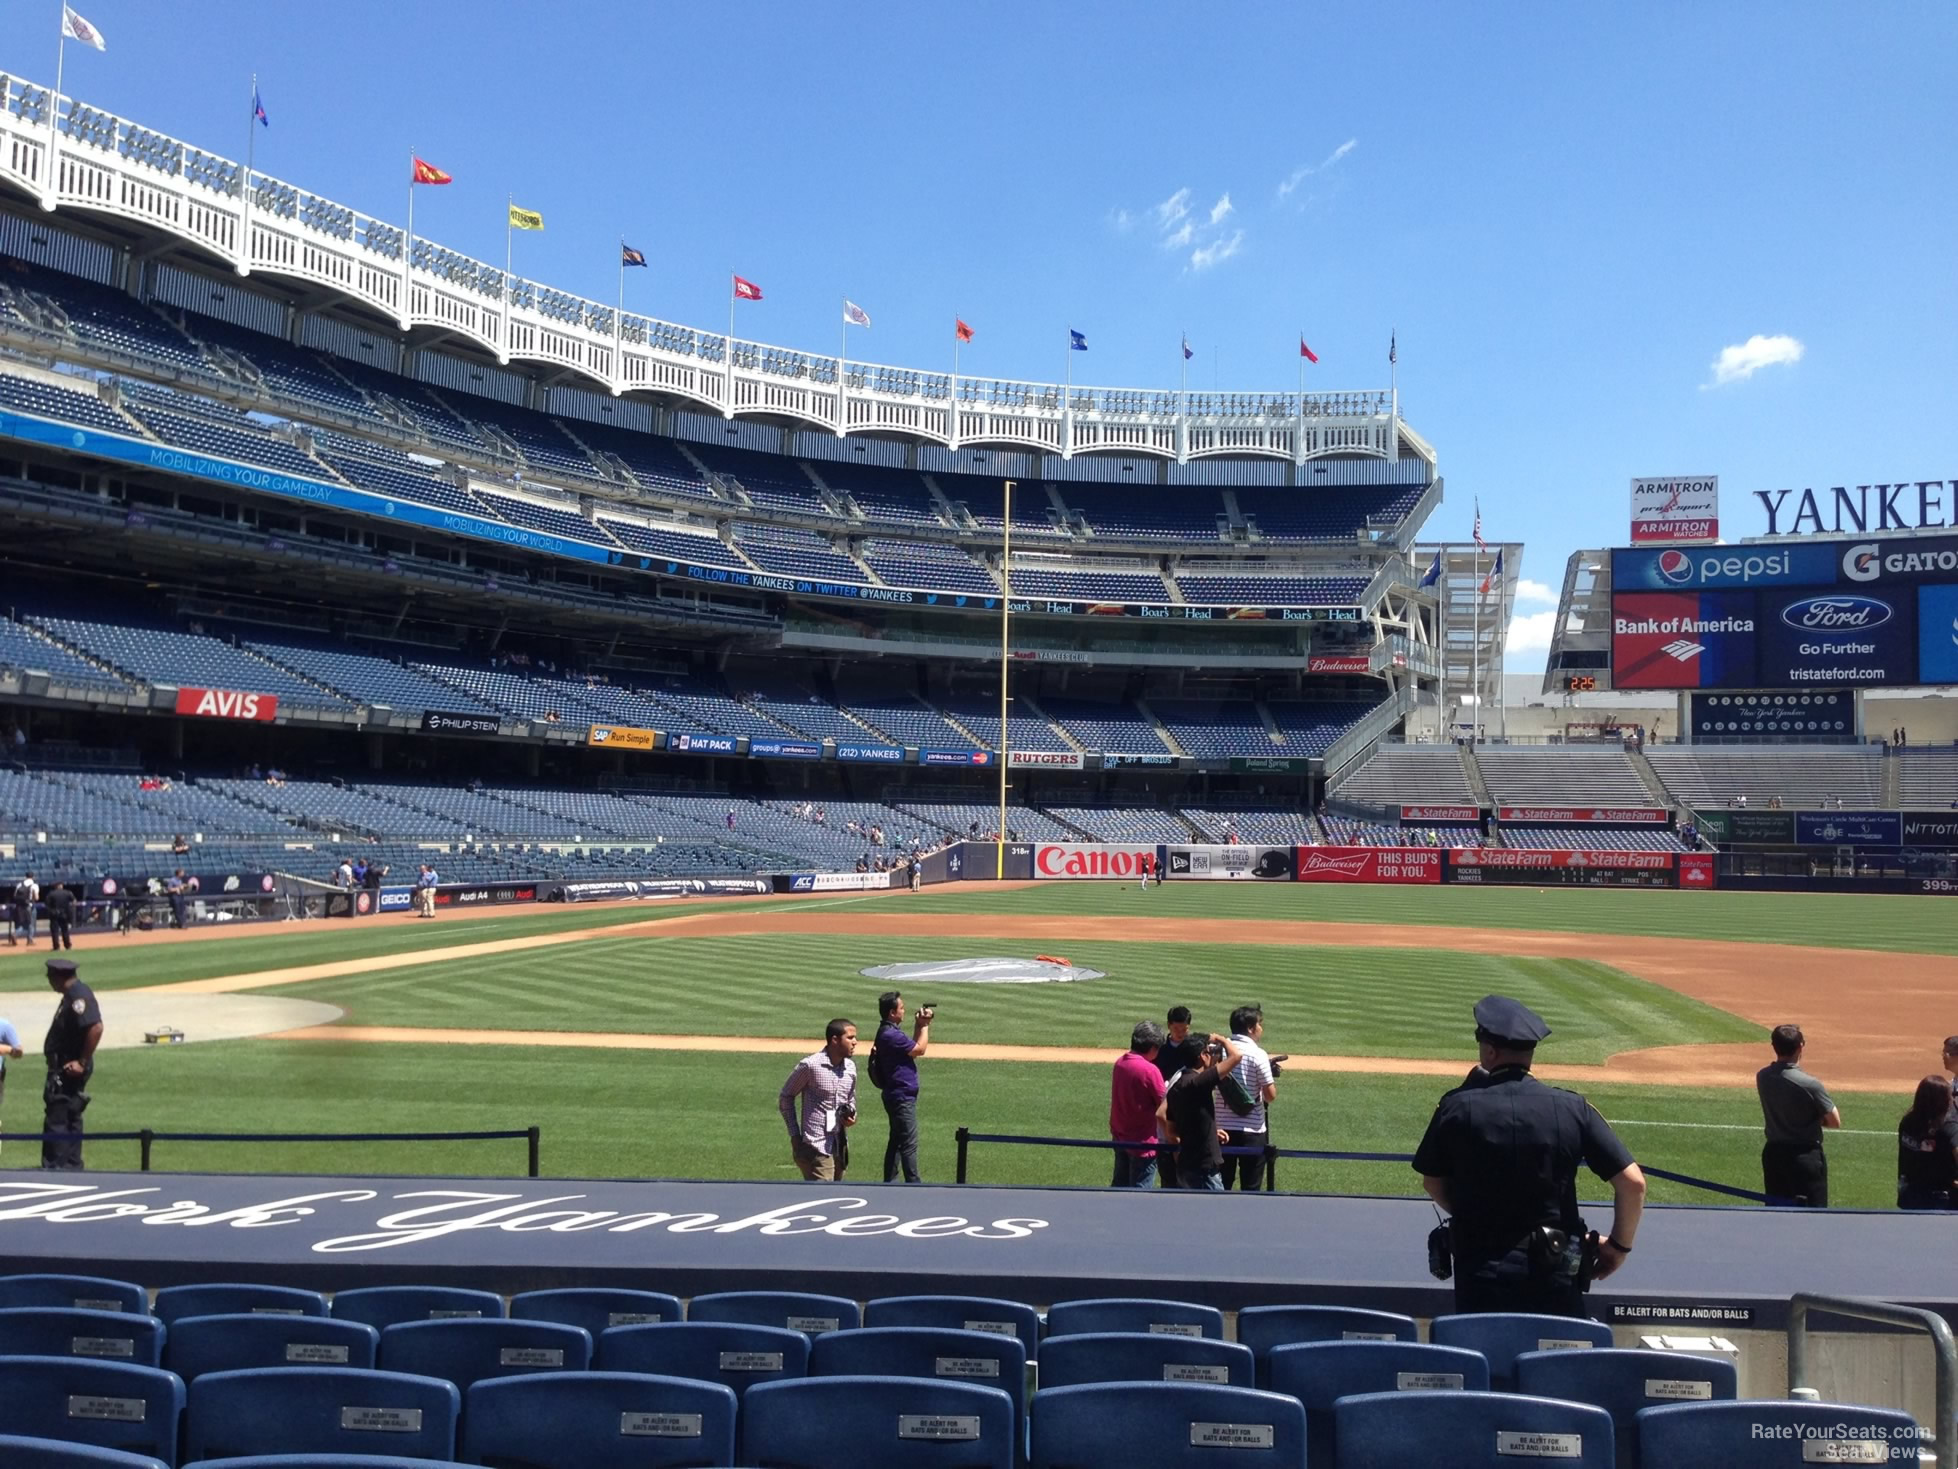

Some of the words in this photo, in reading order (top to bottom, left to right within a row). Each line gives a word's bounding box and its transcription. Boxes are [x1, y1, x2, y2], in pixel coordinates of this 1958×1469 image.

[150, 450, 231, 479] MOBILIZING
[234, 468, 270, 488] YOUR
[272, 477, 332, 500] GAMEDAY
[1635, 482, 1714, 494] ARMITRON
[1640, 522, 1710, 532] ARMITRON
[444, 516, 501, 538] MOBILIZING
[502, 528, 528, 544] YOUR
[530, 535, 562, 551] WORLD
[1701, 551, 1790, 583] pepsi
[1885, 552, 1958, 572] GATO
[688, 566, 727, 582] FOLLOW
[730, 572, 749, 584] THE
[752, 577, 794, 590] YANKEES
[797, 582, 812, 592] ON
[816, 584, 857, 597] TWITTER
[860, 588, 912, 602] @YANKEES
[1046, 603, 1072, 614] Head
[1141, 606, 1169, 617] Boar's
[1185, 608, 1212, 619] Head
[1283, 609, 1312, 620] Boar's
[1328, 609, 1356, 620] Head
[1802, 601, 1872, 626] Ford
[1615, 618, 1657, 634] Bank
[1660, 617, 1679, 633] of
[1680, 617, 1754, 633] America
[1799, 644, 1820, 654] Go
[1823, 643, 1875, 654] Further
[1039, 653, 1069, 661] YANKEES
[1071, 653, 1088, 662] CLUB
[1310, 658, 1368, 671] Budweiser
[1789, 667, 1885, 680] tristateford.com
[196, 690, 259, 719] AVIS
[442, 718, 472, 729] PHILIP
[473, 720, 498, 732] STEIN
[594, 730, 608, 742] SAP
[611, 732, 625, 742] Run
[627, 733, 650, 745] Simple
[691, 739, 708, 748] HAT
[710, 740, 731, 750] PACK
[752, 745, 780, 753] groups@
[839, 748, 858, 757] (212)
[861, 749, 900, 759] YANKEES
[1013, 753, 1078, 764] RUTGERS
[1246, 759, 1267, 768] Poland
[1268, 758, 1290, 769] Spring
[1037, 847, 1155, 875] Canon
[1309, 857, 1363, 869] Budweiser
[1377, 853, 1401, 864] THIS
[1405, 853, 1438, 864] BUD'S
[1377, 866, 1399, 877] FOR
[1401, 866, 1426, 877] YOU.
[796, 877, 812, 887] ACC
[381, 894, 410, 905] GEICO
[460, 893, 476, 901] Audi
[516, 890, 533, 899] Audi
[311, 1190, 1049, 1252] Yankees
[1614, 1306, 1624, 1316] BE
[1626, 1307, 1650, 1317] ALERT
[1652, 1308, 1667, 1317] FOR
[1669, 1308, 1690, 1318] BATS
[1691, 1309, 1722, 1319] AND/OR
[1724, 1310, 1749, 1319] BALLS
